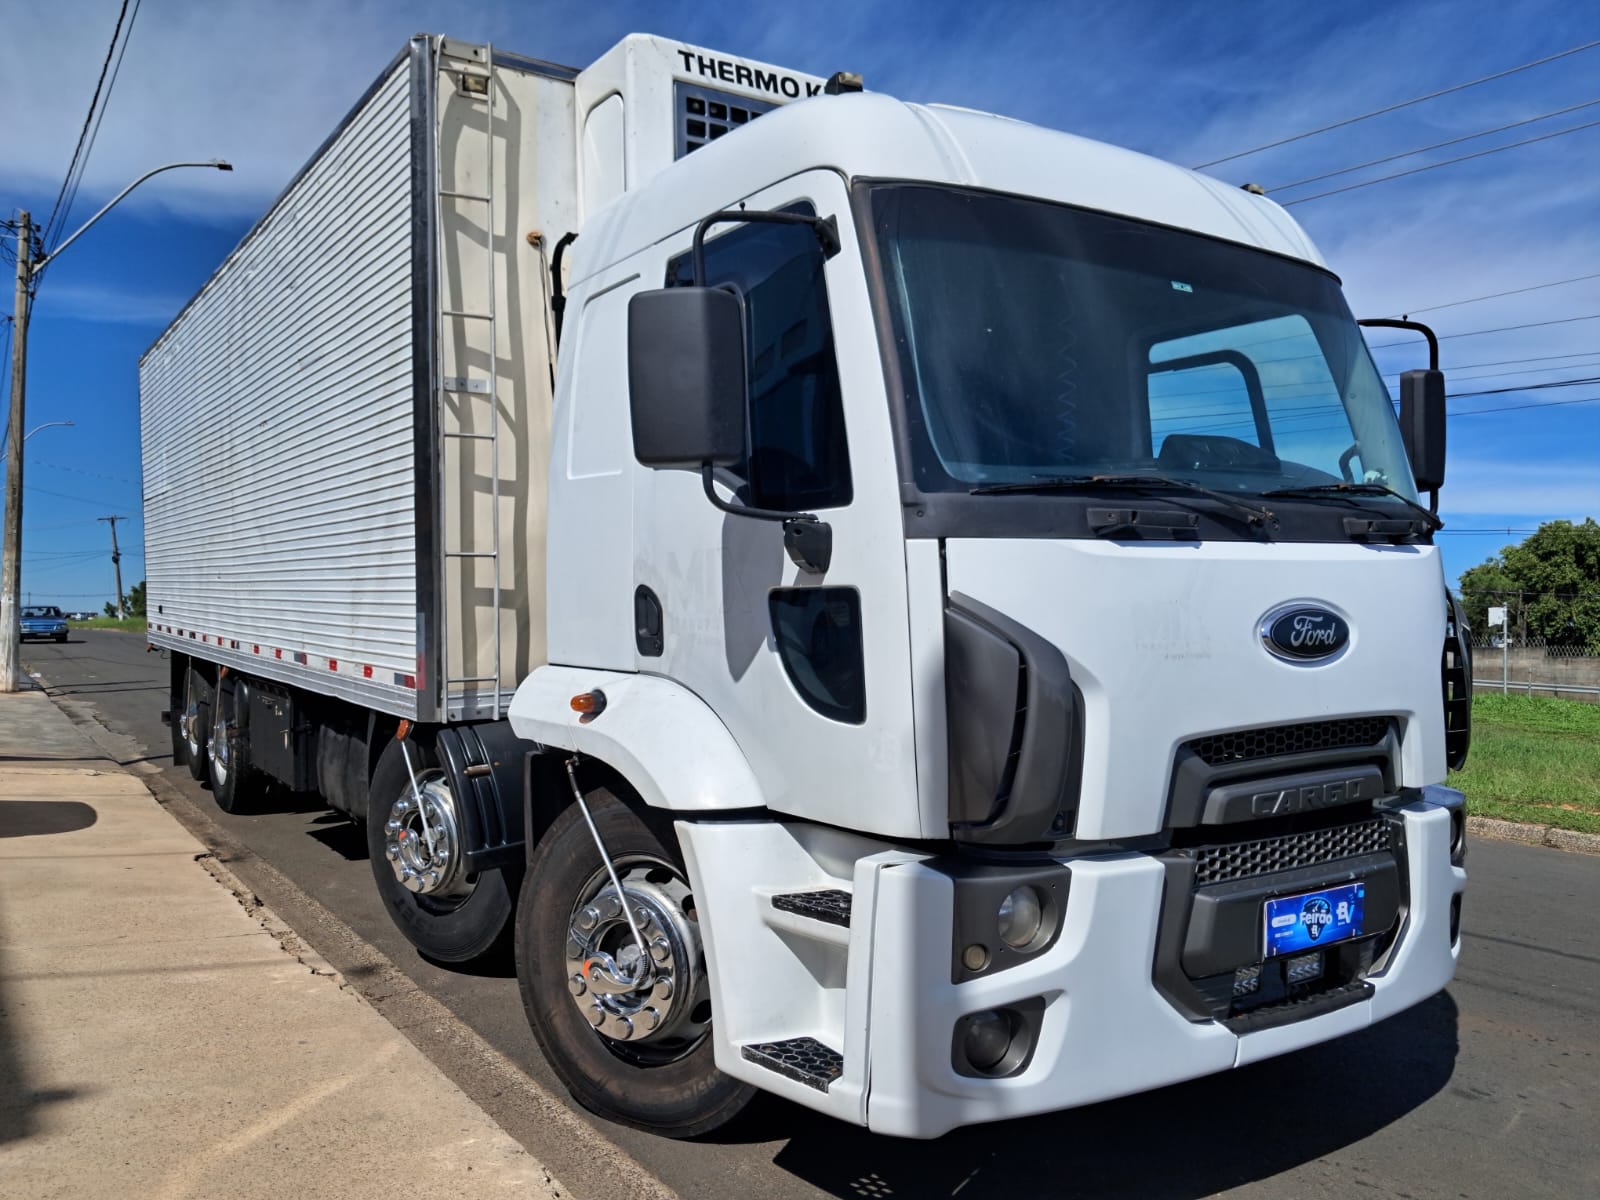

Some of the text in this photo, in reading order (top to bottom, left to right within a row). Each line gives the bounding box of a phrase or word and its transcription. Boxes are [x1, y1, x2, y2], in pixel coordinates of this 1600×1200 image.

[677, 49, 800, 99] THERMO
[1290, 615, 1337, 648] Ford
[1251, 777, 1365, 816] CARGO
[1299, 908, 1333, 927] Feirão
